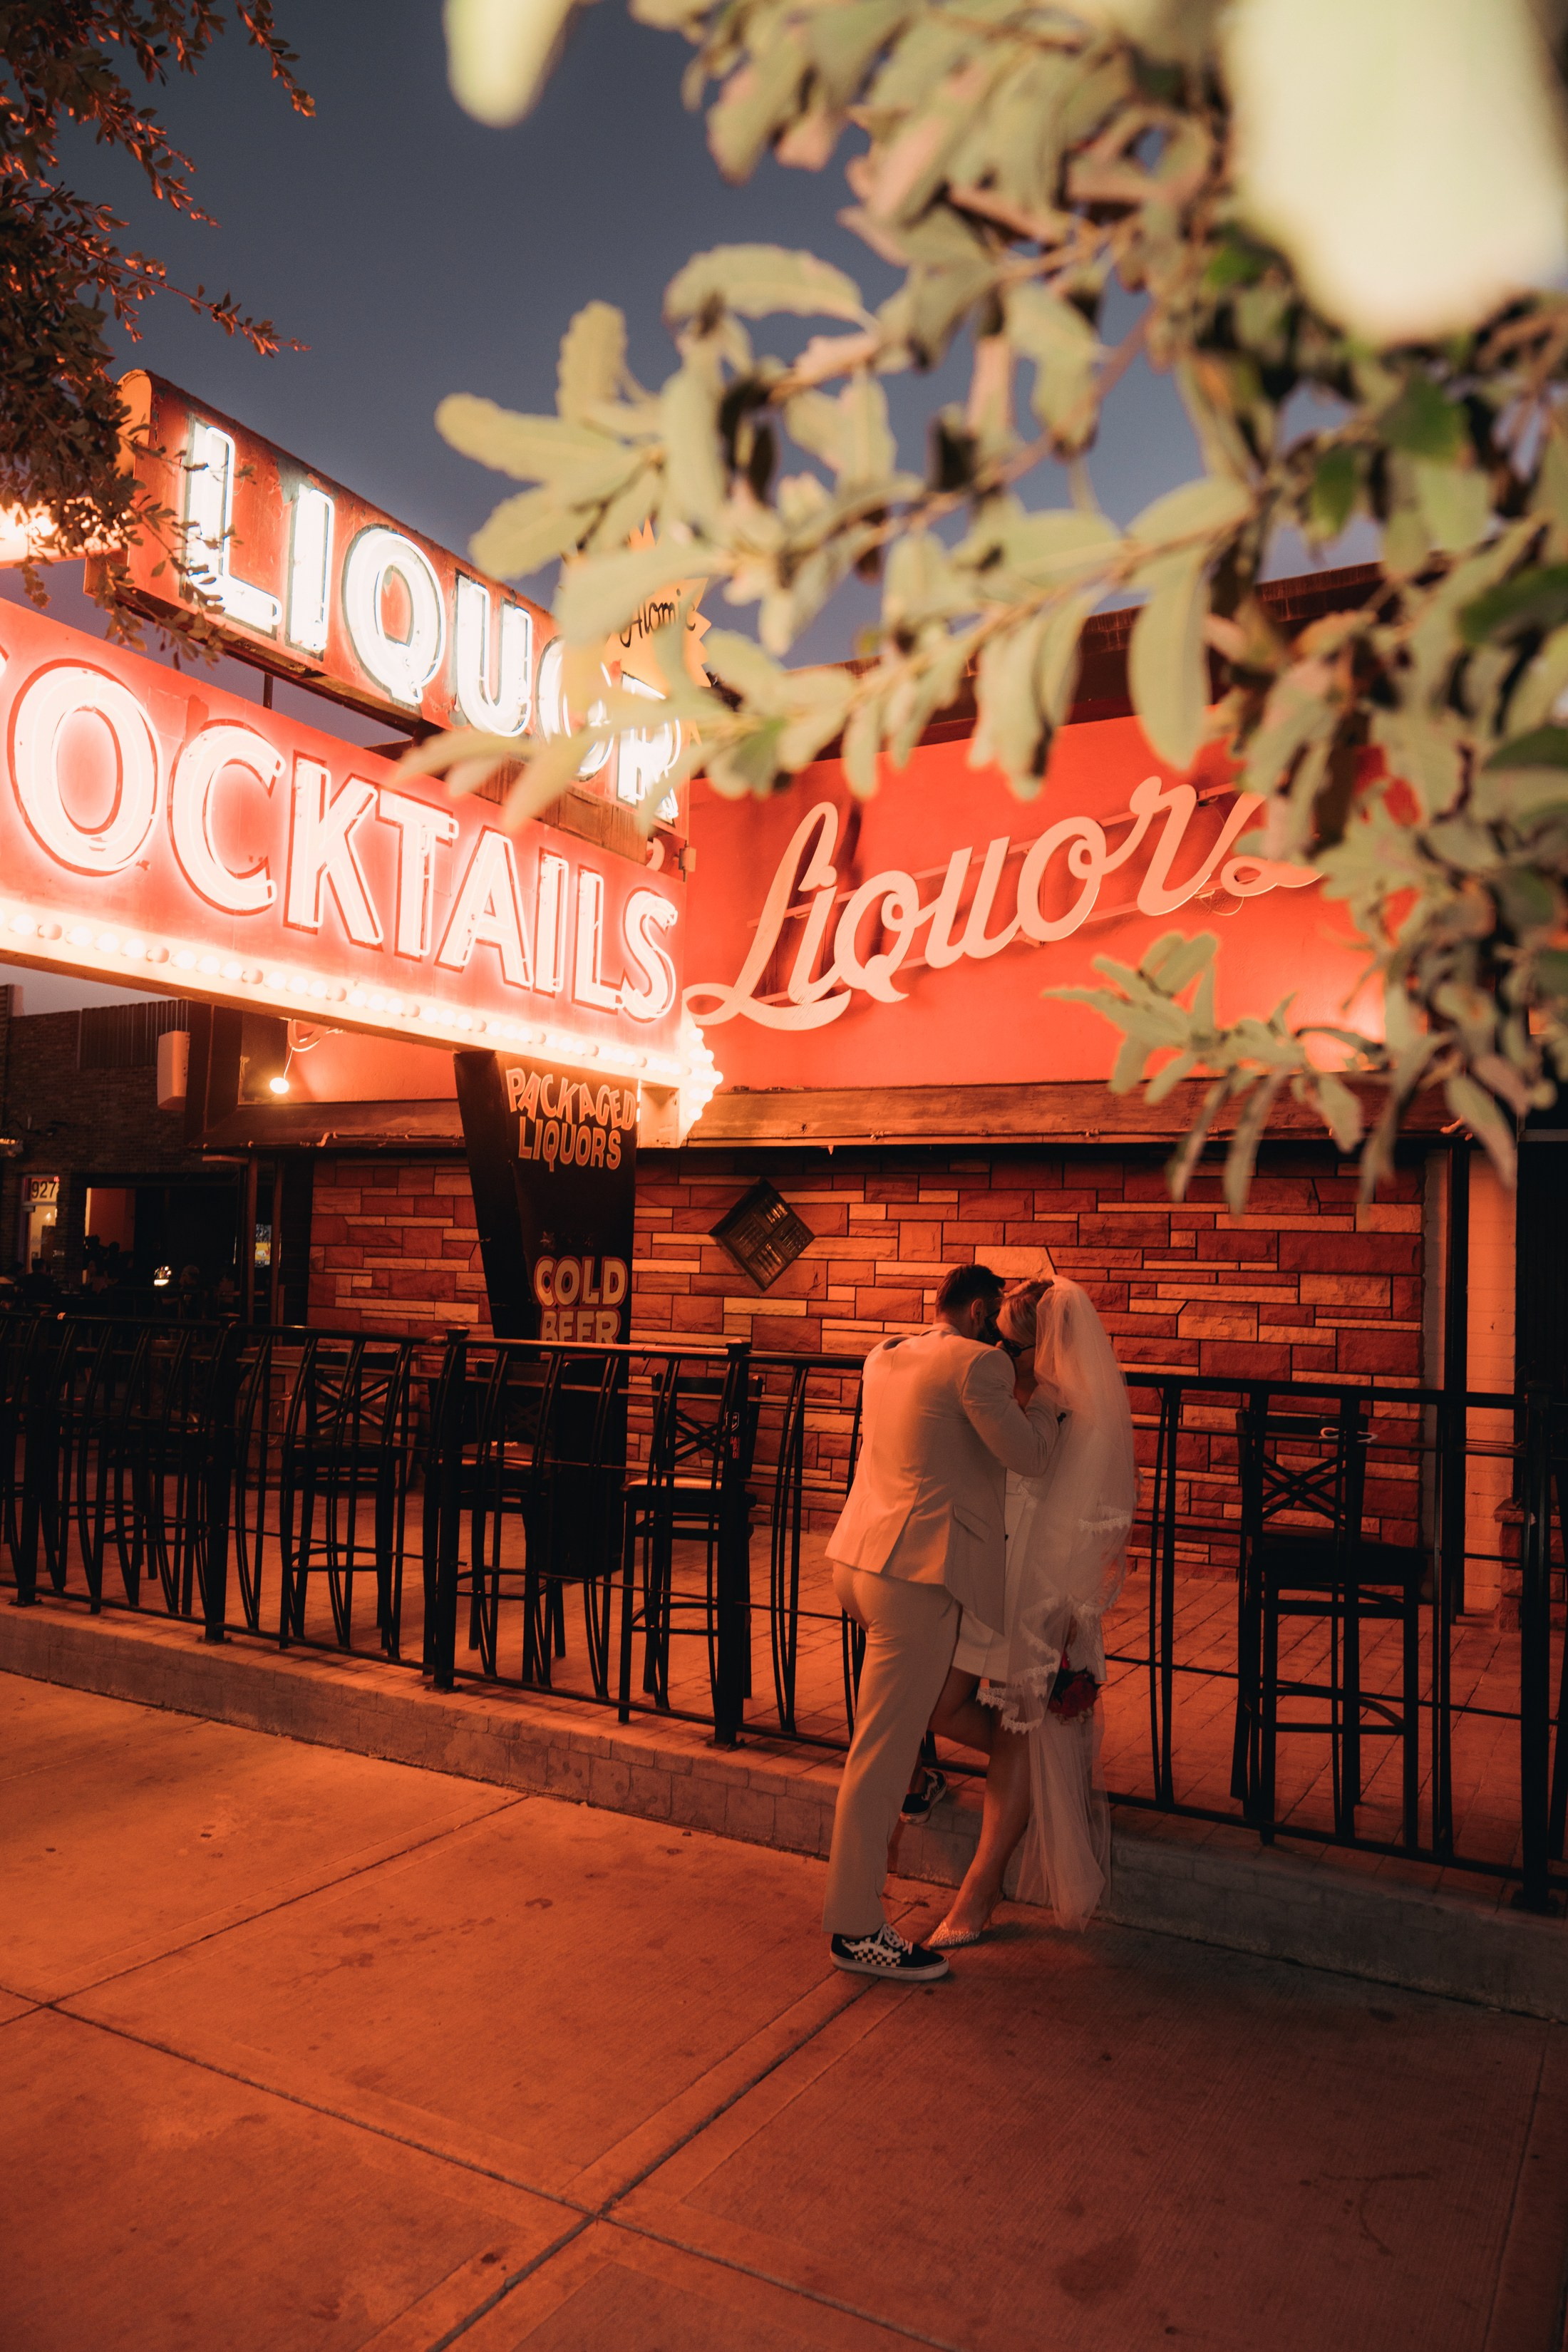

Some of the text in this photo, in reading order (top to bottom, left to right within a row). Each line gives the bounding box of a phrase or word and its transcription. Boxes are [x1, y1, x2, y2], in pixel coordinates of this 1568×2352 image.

[619, 588, 696, 649] Atomc
[0, 645, 680, 1022] OCKTAILS
[505, 1067, 636, 1131] PACKAGED
[518, 1115, 621, 1172] LIQUORS
[31, 1180, 57, 1199] 927
[534, 1255, 628, 1308] COLD
[540, 1308, 621, 1345] BEER
